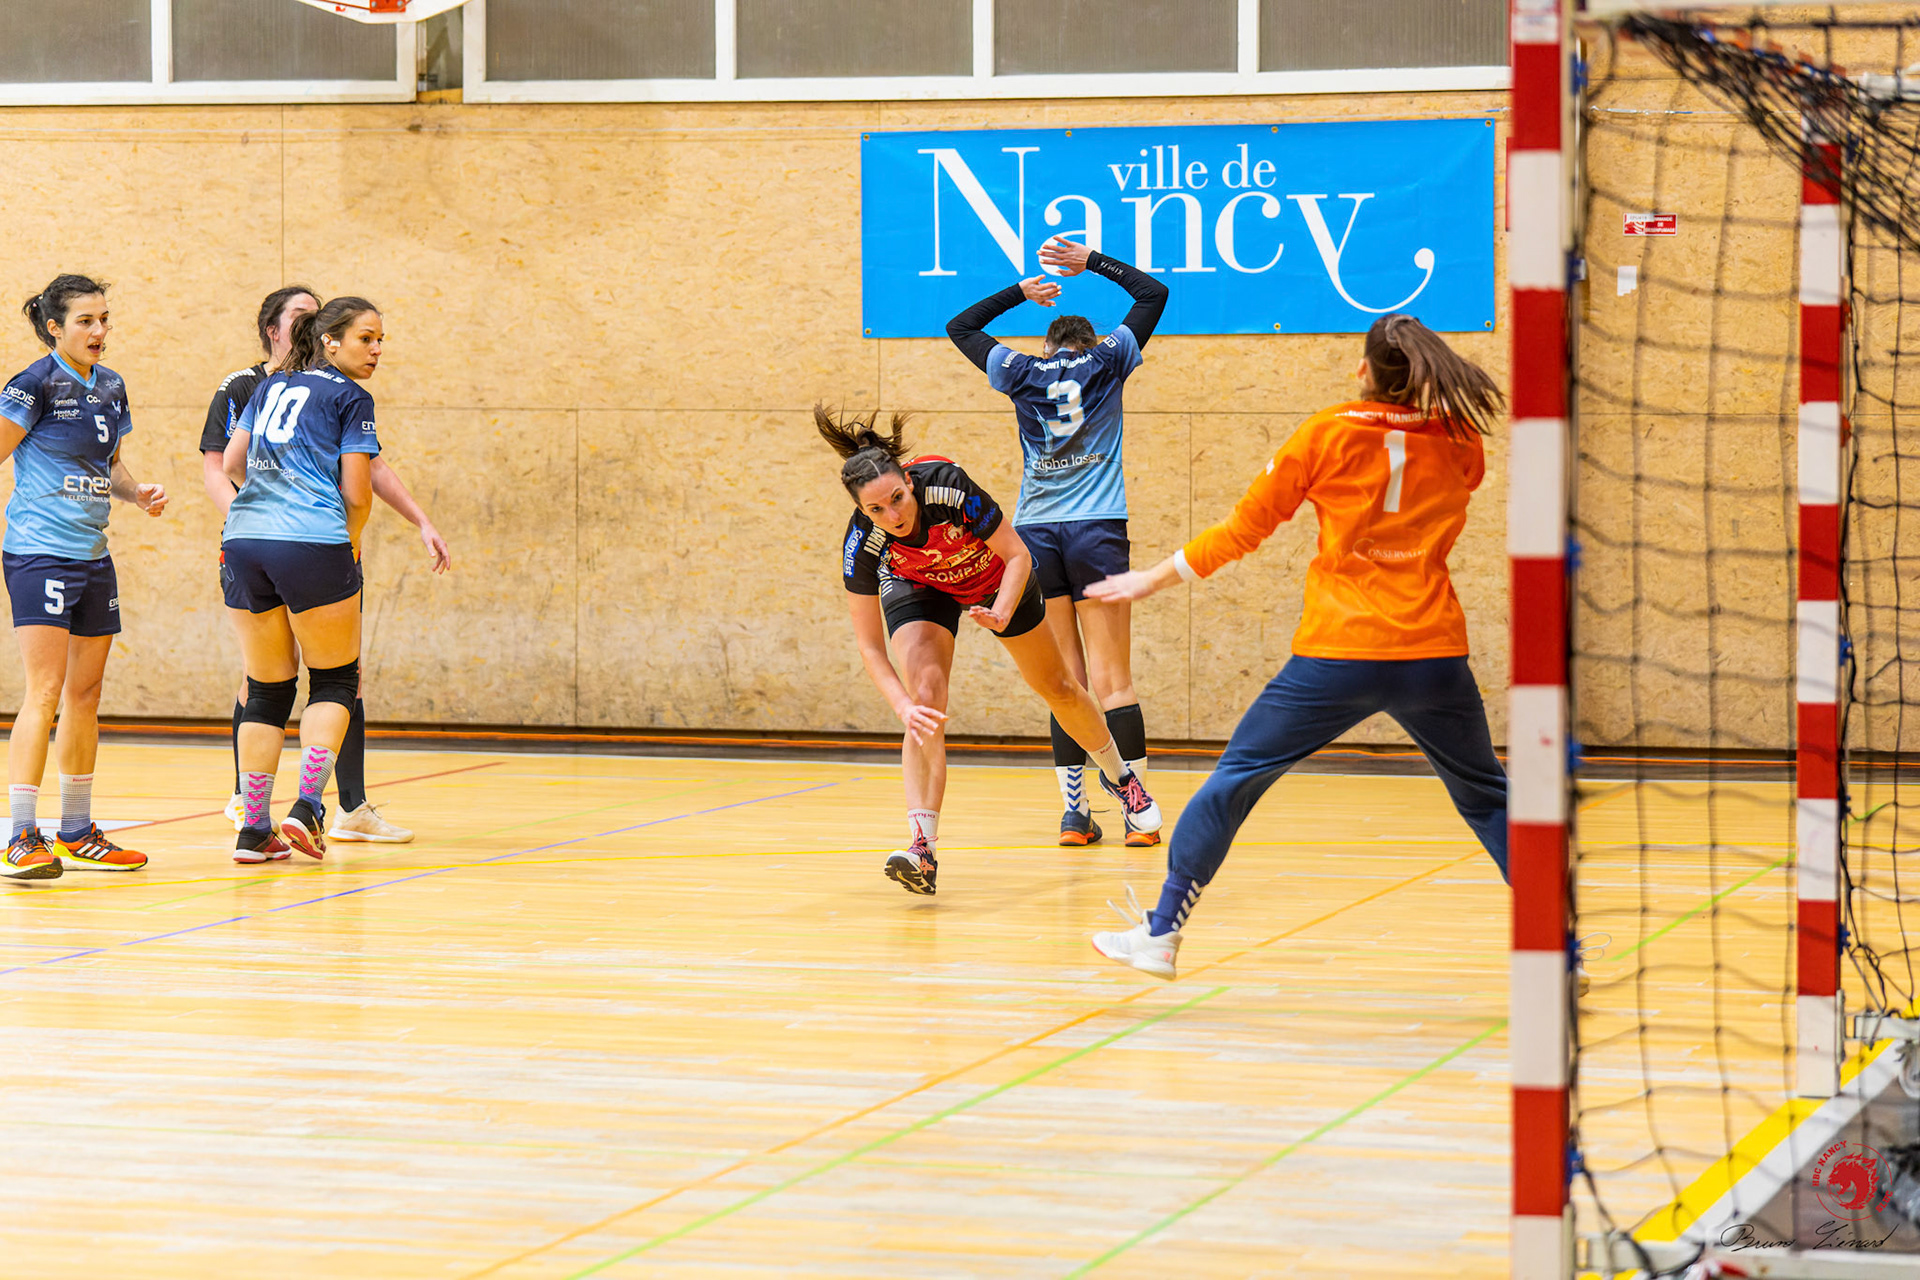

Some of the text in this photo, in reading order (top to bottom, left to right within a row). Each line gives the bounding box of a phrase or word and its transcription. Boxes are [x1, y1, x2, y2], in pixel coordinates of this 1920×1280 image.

[1108, 143, 1277, 191] ville de
[917, 146, 1434, 314] Nancy
[94, 414, 109, 443] 5
[252, 381, 311, 444] 10
[1045, 379, 1085, 438] 3
[1031, 450, 1101, 473] alpha laser
[1383, 429, 1406, 513] 1
[44, 579, 65, 615] 5
